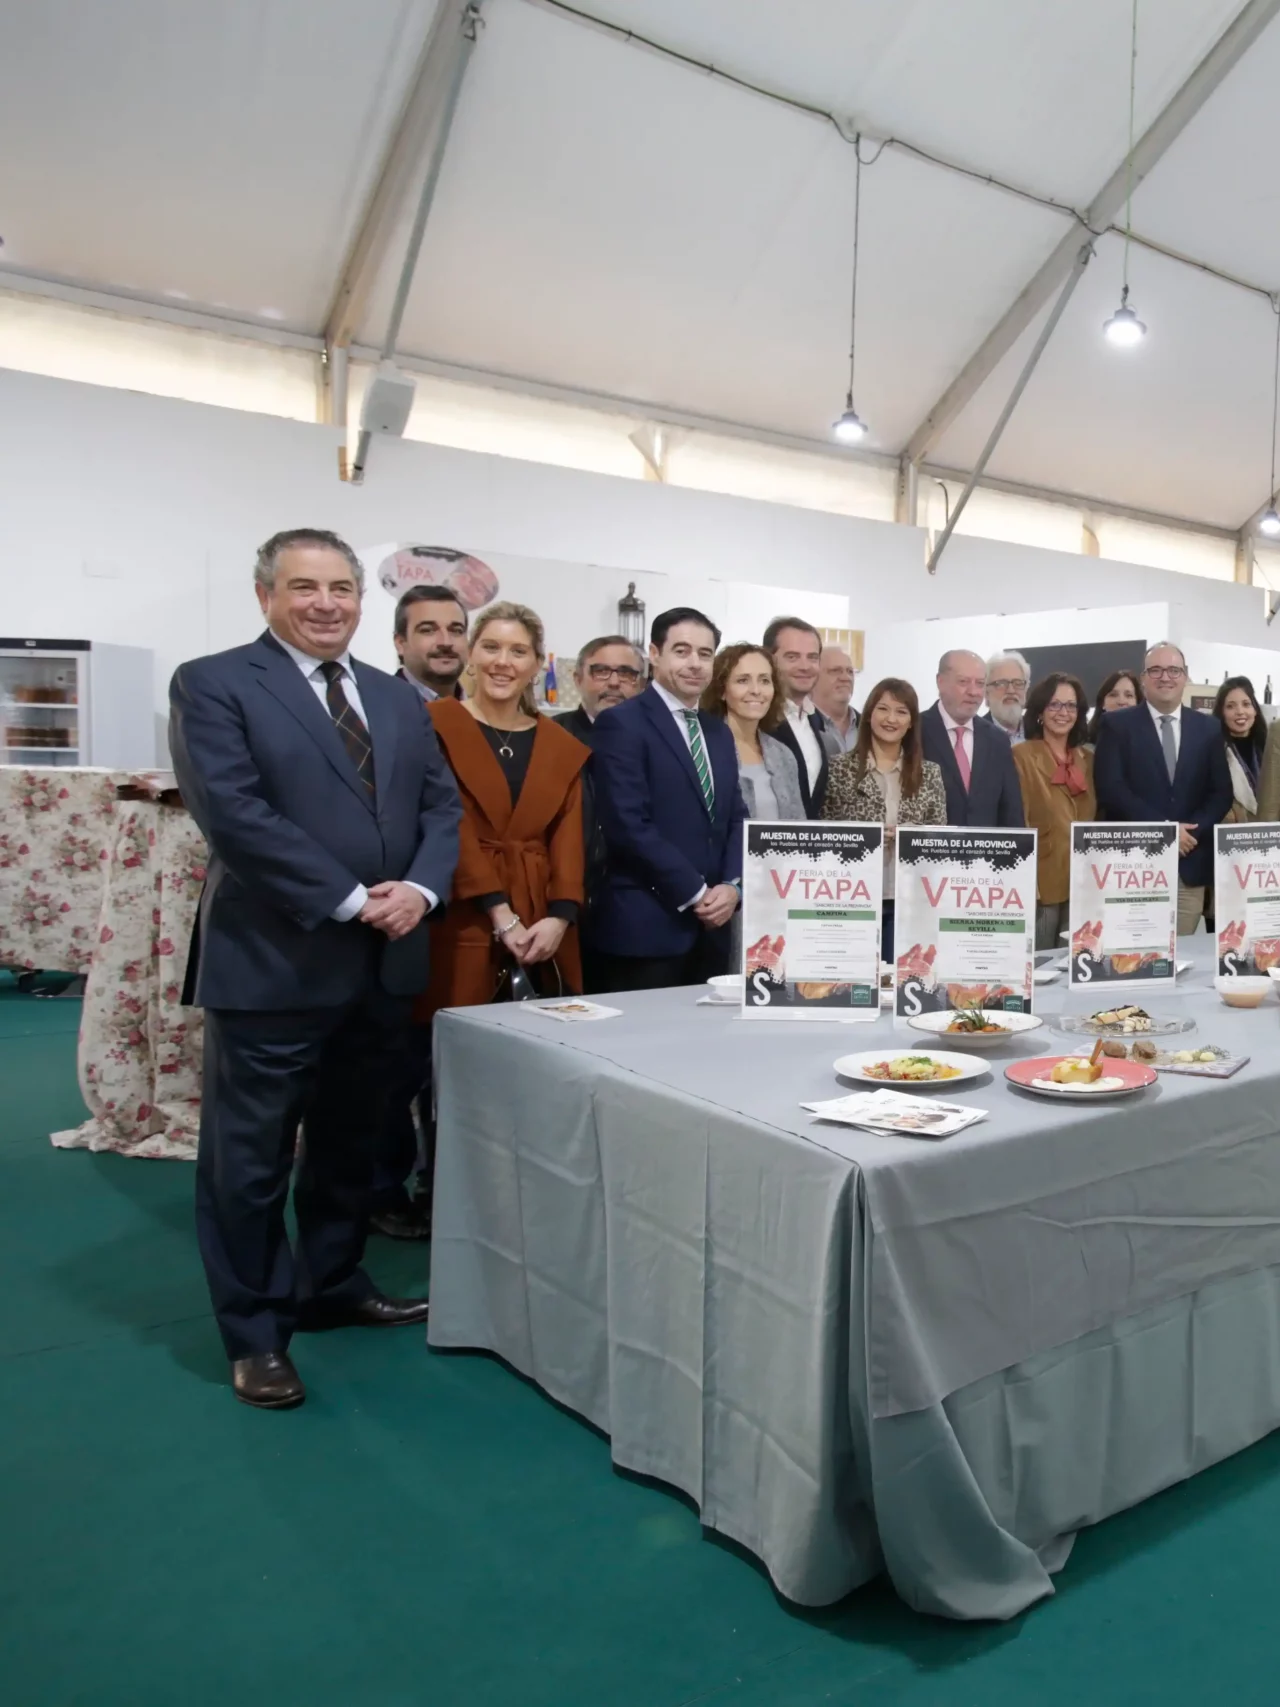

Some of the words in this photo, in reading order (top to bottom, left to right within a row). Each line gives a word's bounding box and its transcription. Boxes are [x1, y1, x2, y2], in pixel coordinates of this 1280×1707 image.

[822, 833, 864, 841] PROVINCIA
[974, 840, 1017, 848] PROVINCIA
[770, 869, 797, 899] V
[799, 878, 871, 900] TAPA
[1091, 864, 1111, 890] V
[1114, 871, 1168, 888] TAPA
[1234, 864, 1252, 889] V
[921, 877, 948, 908] V
[950, 887, 1024, 909] TAPA
[1077, 953, 1092, 982] S
[752, 972, 771, 1006] S
[904, 982, 922, 1015] S
